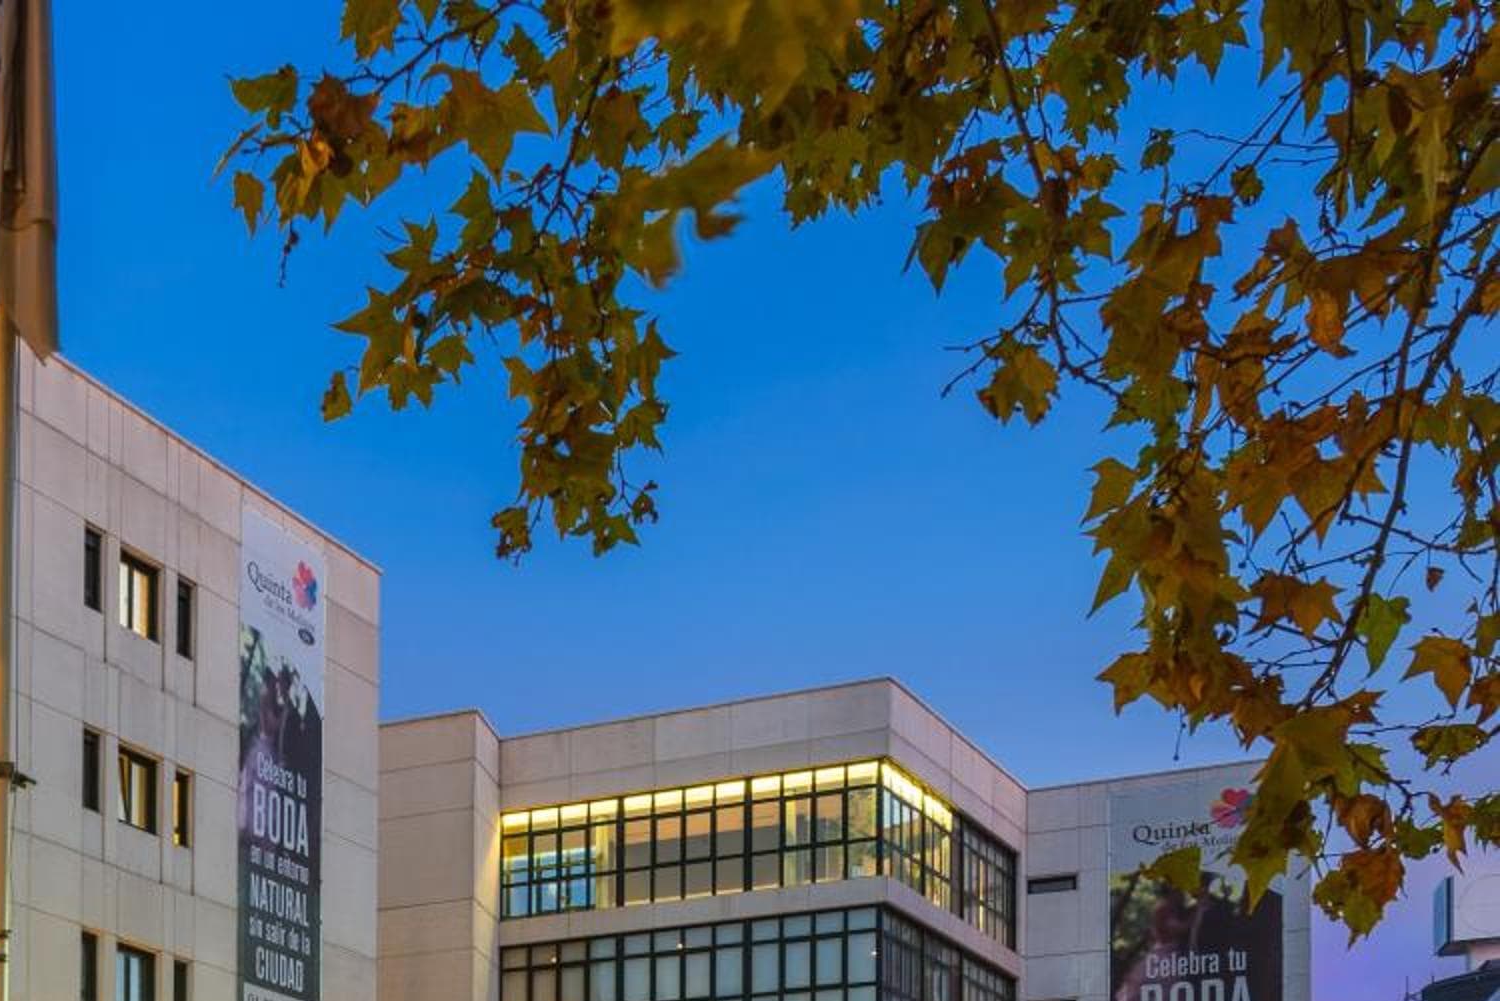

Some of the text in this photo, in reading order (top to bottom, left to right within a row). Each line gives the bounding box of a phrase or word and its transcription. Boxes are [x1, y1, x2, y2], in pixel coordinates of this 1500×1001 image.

[247, 561, 293, 606] Quinta
[297, 771, 307, 799] tu
[252, 781, 309, 858] BODA
[1133, 820, 1211, 846] Quinta
[249, 872, 309, 928] NATURAL
[301, 930, 311, 956] la
[255, 945, 304, 993] CIUDAD
[1145, 948, 1247, 980] Celebra tu
